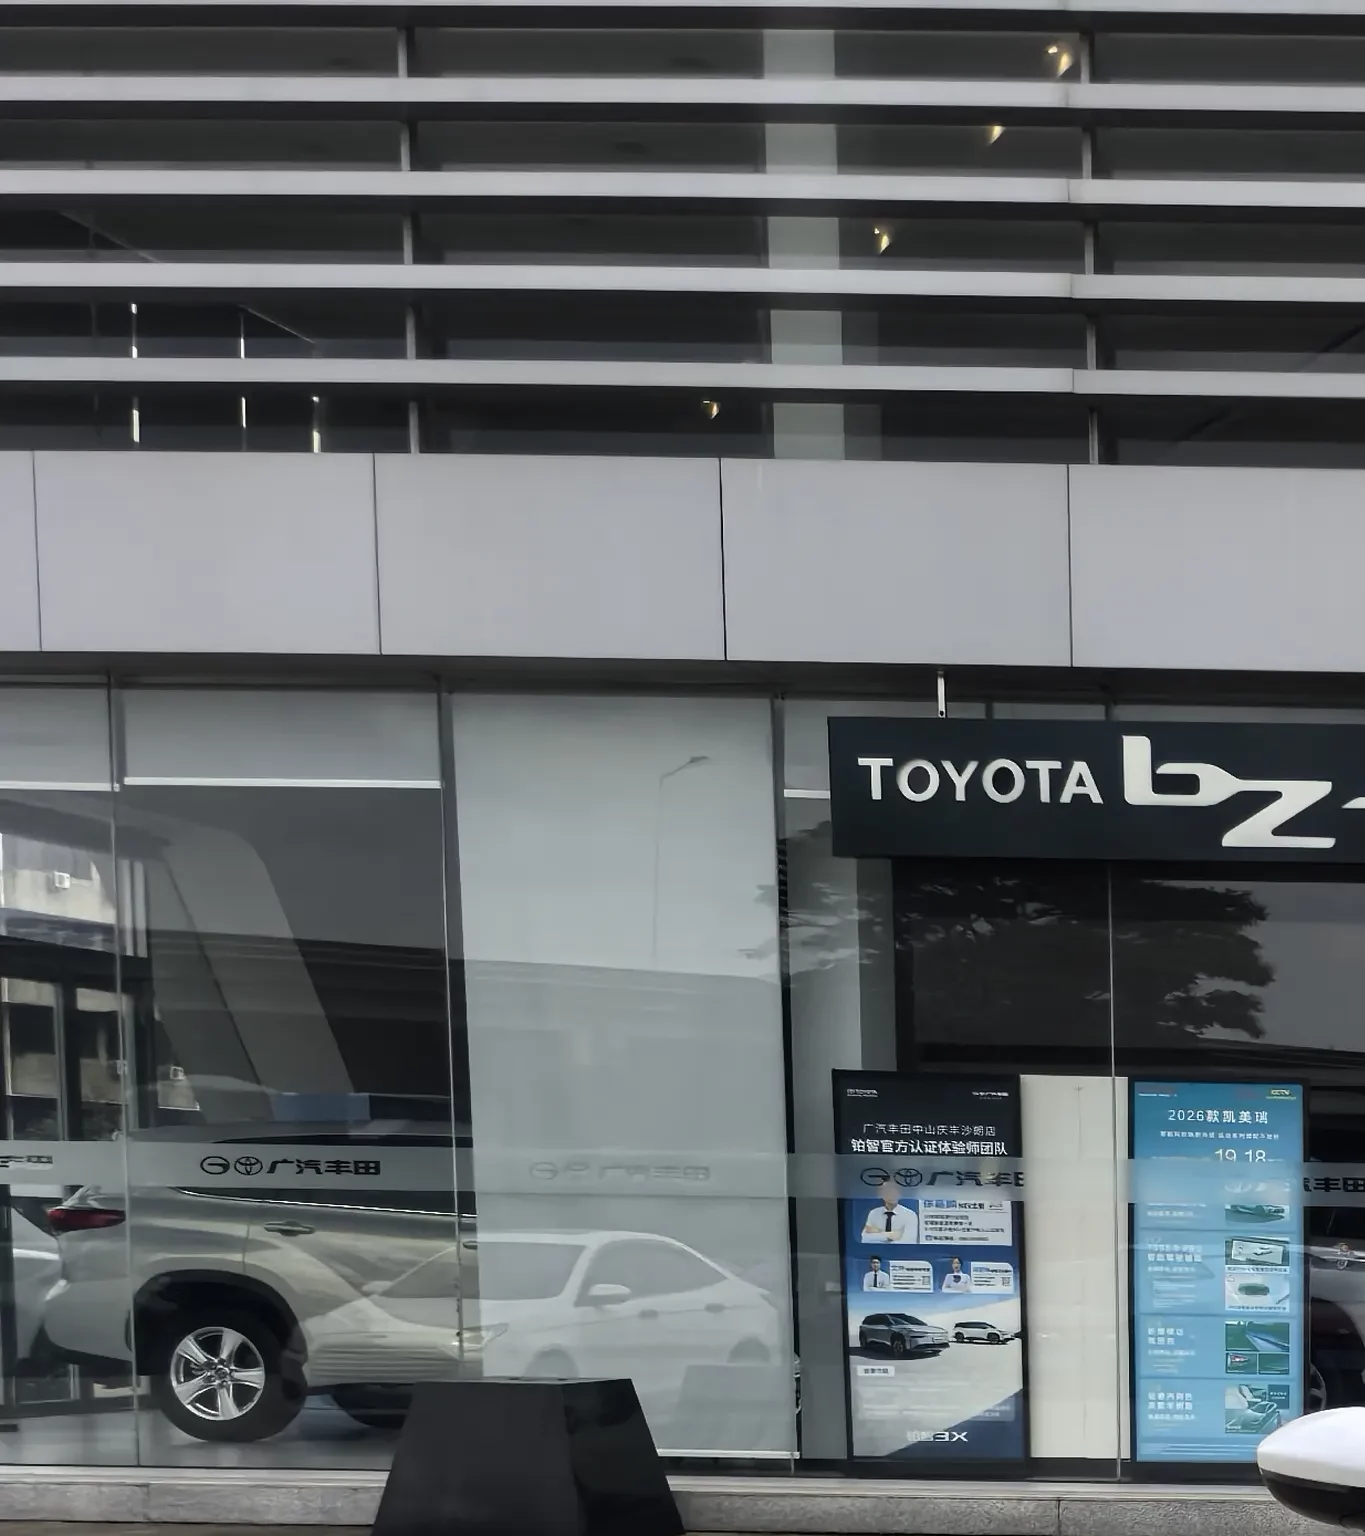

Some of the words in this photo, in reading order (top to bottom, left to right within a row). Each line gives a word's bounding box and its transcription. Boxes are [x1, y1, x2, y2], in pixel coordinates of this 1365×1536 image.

[858, 757, 1104, 805] TOYOTA
[850, 1138, 1008, 1156] 铂智官方认证体验师团队
[266, 1159, 381, 1175] 广汽丰田
